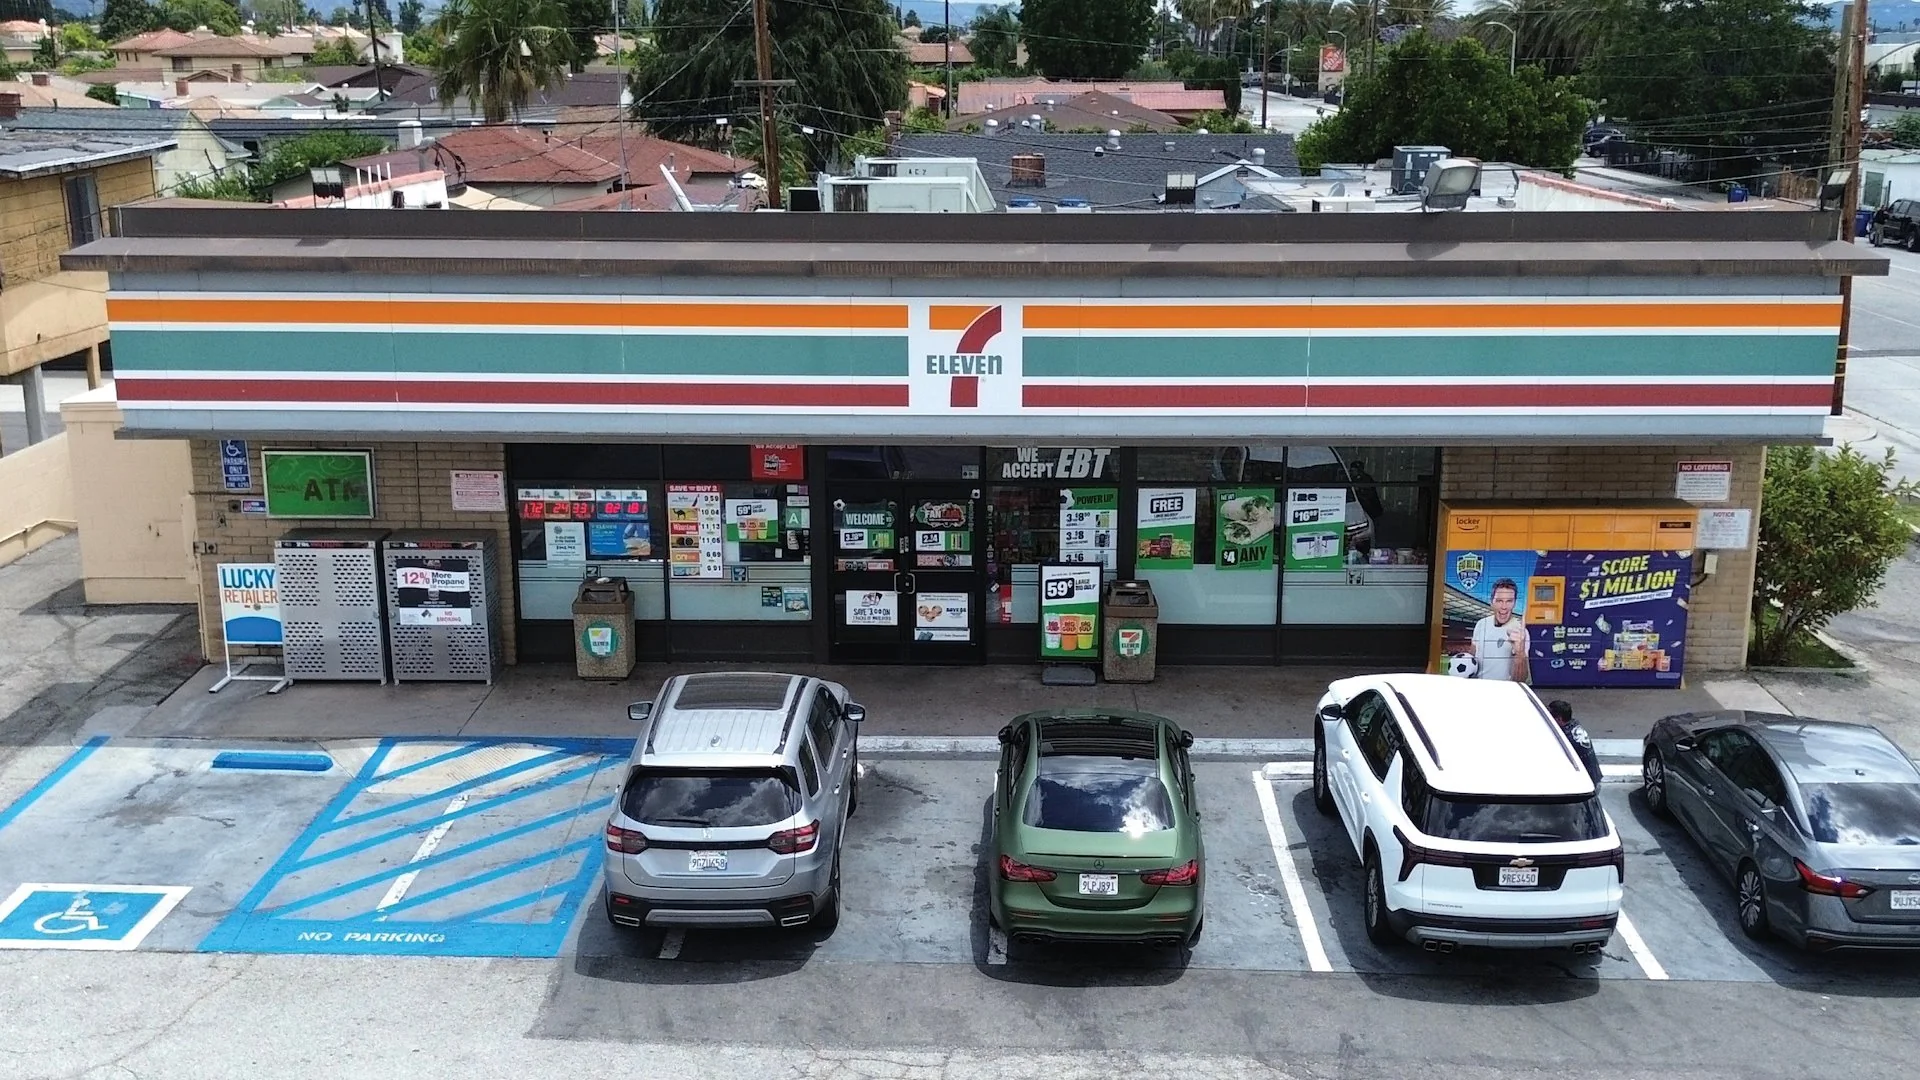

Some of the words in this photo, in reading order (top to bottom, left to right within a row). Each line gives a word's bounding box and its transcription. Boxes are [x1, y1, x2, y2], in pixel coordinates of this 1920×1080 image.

[929, 304, 1002, 408] 7
[1017, 447, 1039, 462] WE
[1002, 462, 1054, 479] ACCEPT
[1055, 448, 1111, 478] EBT
[1076, 494, 1103, 505] POWER
[1103, 493, 1114, 503] UP
[1152, 498, 1182, 512] FREE
[788, 512, 799, 524] A
[845, 513, 885, 526] WELCOME
[1456, 517, 1480, 525] locker
[1223, 550, 1235, 563] $4
[1240, 546, 1268, 562] ANY
[1600, 555, 1651, 576] SCORE
[222, 568, 276, 589] LUCKY
[401, 572, 430, 585] 12%
[1579, 578, 1600, 601] $1
[1602, 569, 1677, 596] MILLION
[1047, 580, 1073, 597] 59¢
[224, 590, 279, 604] RETAILER
[1501, 873, 1536, 883] 9RES450
[297, 931, 333, 941] NO
[343, 932, 446, 943] PARKING
